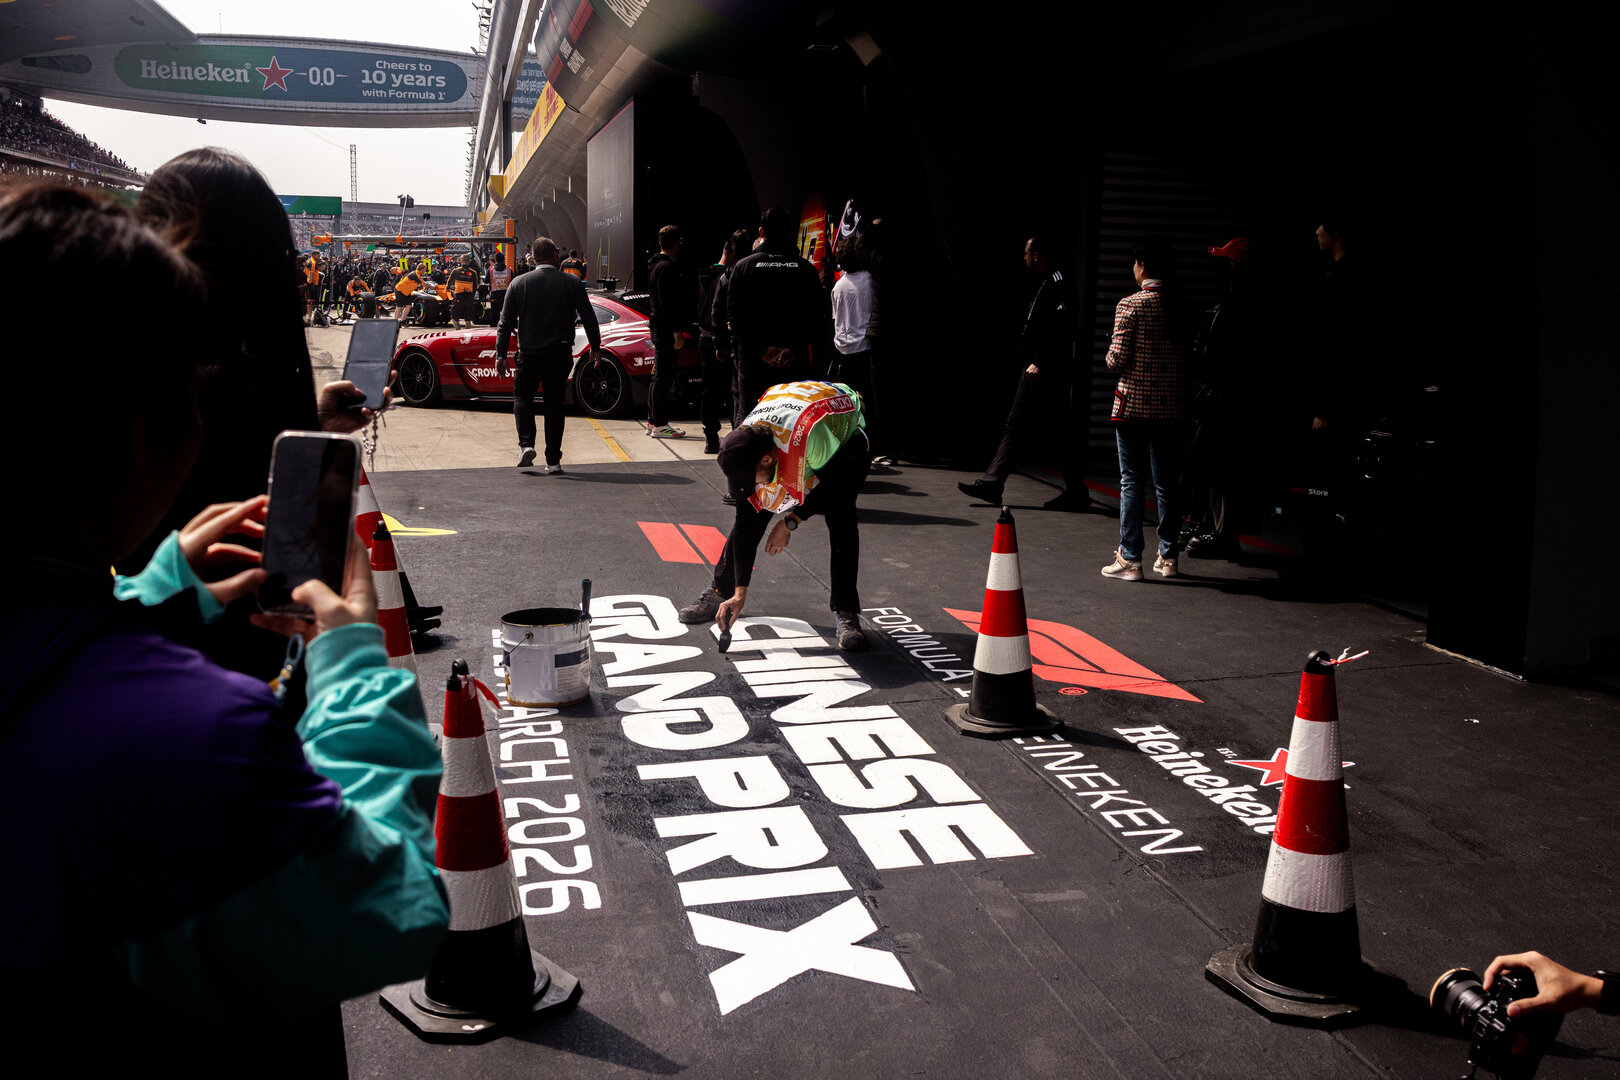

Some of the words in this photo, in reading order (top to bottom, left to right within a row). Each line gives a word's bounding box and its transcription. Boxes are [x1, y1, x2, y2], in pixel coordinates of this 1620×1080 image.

[362, 69, 387, 84] 10
[391, 71, 446, 88] years
[362, 89, 387, 99] with
[388, 89, 436, 99] Formula
[375, 60, 417, 72] Cheers
[419, 62, 432, 72] to
[472, 368, 516, 378] CROWST
[792, 425, 805, 447] 2026
[1308, 488, 1329, 497] Store
[580, 594, 750, 751] GRAND
[863, 607, 974, 682] FORMULA
[497, 685, 573, 785] ARCH
[709, 616, 1035, 870] CHINESE
[1012, 733, 1204, 855] INEKEN
[503, 793, 602, 916] 2026
[637, 755, 917, 1016] PRIX
